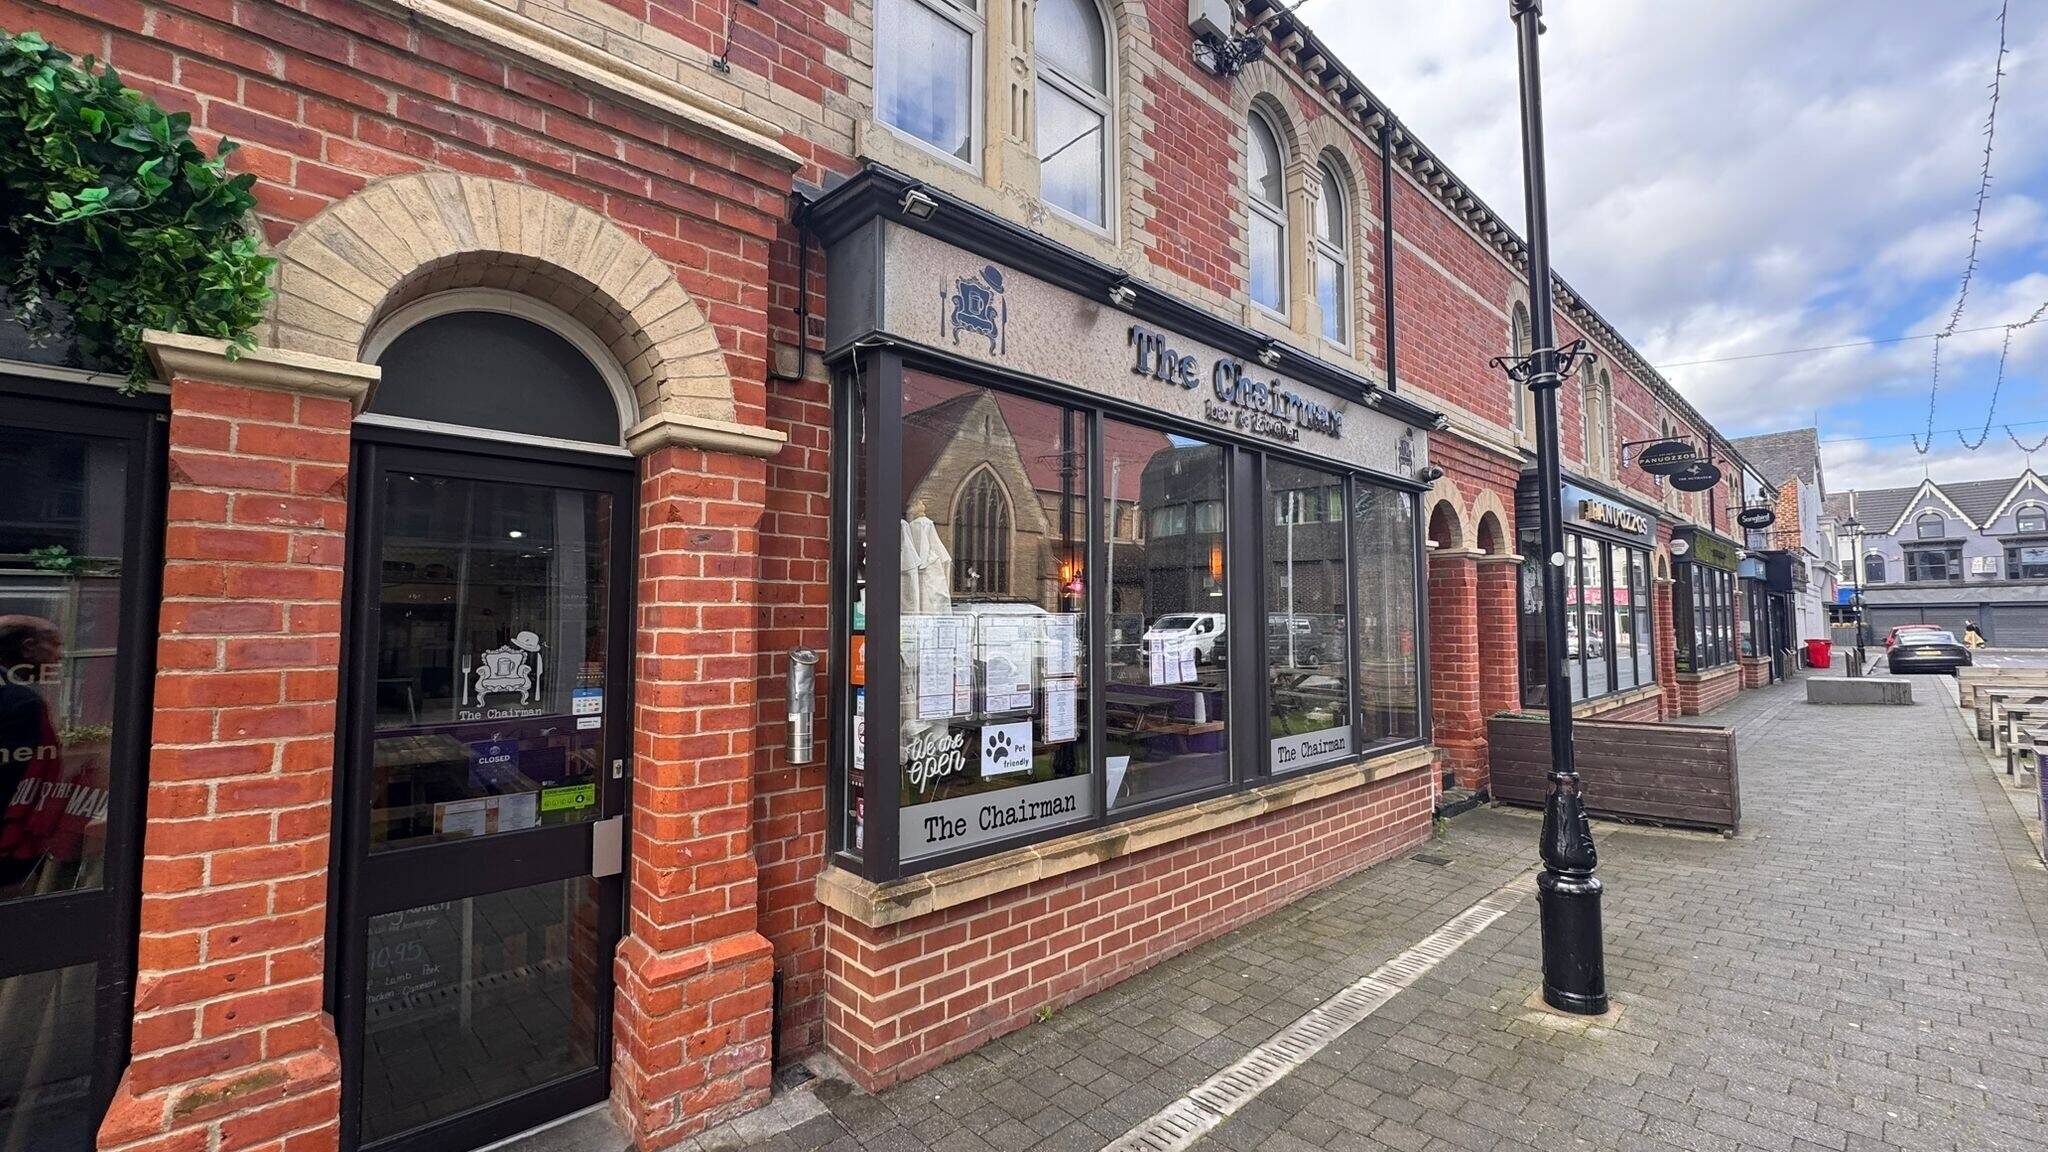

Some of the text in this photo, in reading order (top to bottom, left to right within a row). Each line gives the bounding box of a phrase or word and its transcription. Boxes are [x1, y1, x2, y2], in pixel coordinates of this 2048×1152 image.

[1128, 324, 1345, 439] The Chairman
[1639, 453, 1696, 465] PANUOZZOS
[0, 663, 62, 687] GE
[459, 708, 542, 721] The Chairman
[906, 732, 964, 761] We are
[1014, 744, 1026, 753] Pet
[1277, 738, 1346, 763] The Chairman
[478, 754, 511, 765] CLOSED
[1003, 759, 1029, 769] friendly
[907, 750, 966, 794] open
[924, 794, 1076, 843] The Chairman
[367, 990, 395, 1004] hicken
